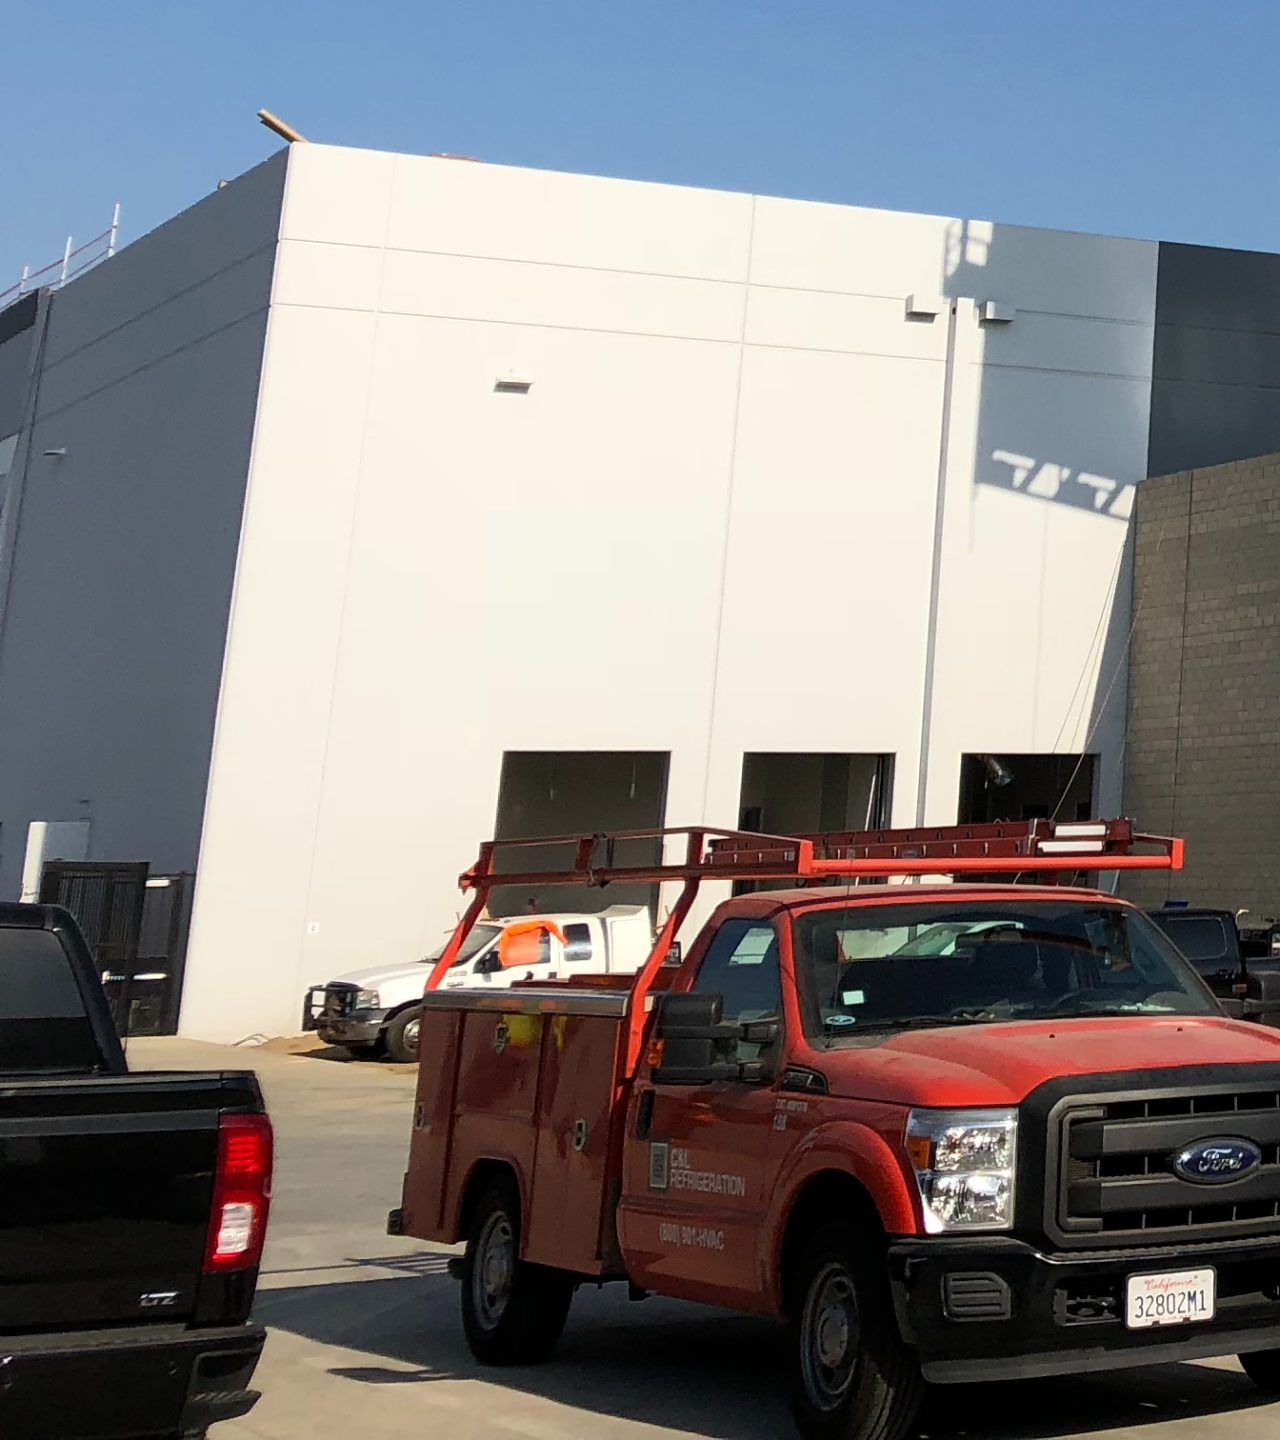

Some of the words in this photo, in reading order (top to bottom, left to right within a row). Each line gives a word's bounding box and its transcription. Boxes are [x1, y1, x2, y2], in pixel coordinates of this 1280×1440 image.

[671, 1148, 690, 1168] C&L
[1198, 1148, 1244, 1172] Ford
[670, 1168, 745, 1197] REFRIGERATION
[140, 1292, 178, 1307] LTZ
[1134, 1289, 1207, 1320] 32802M1
